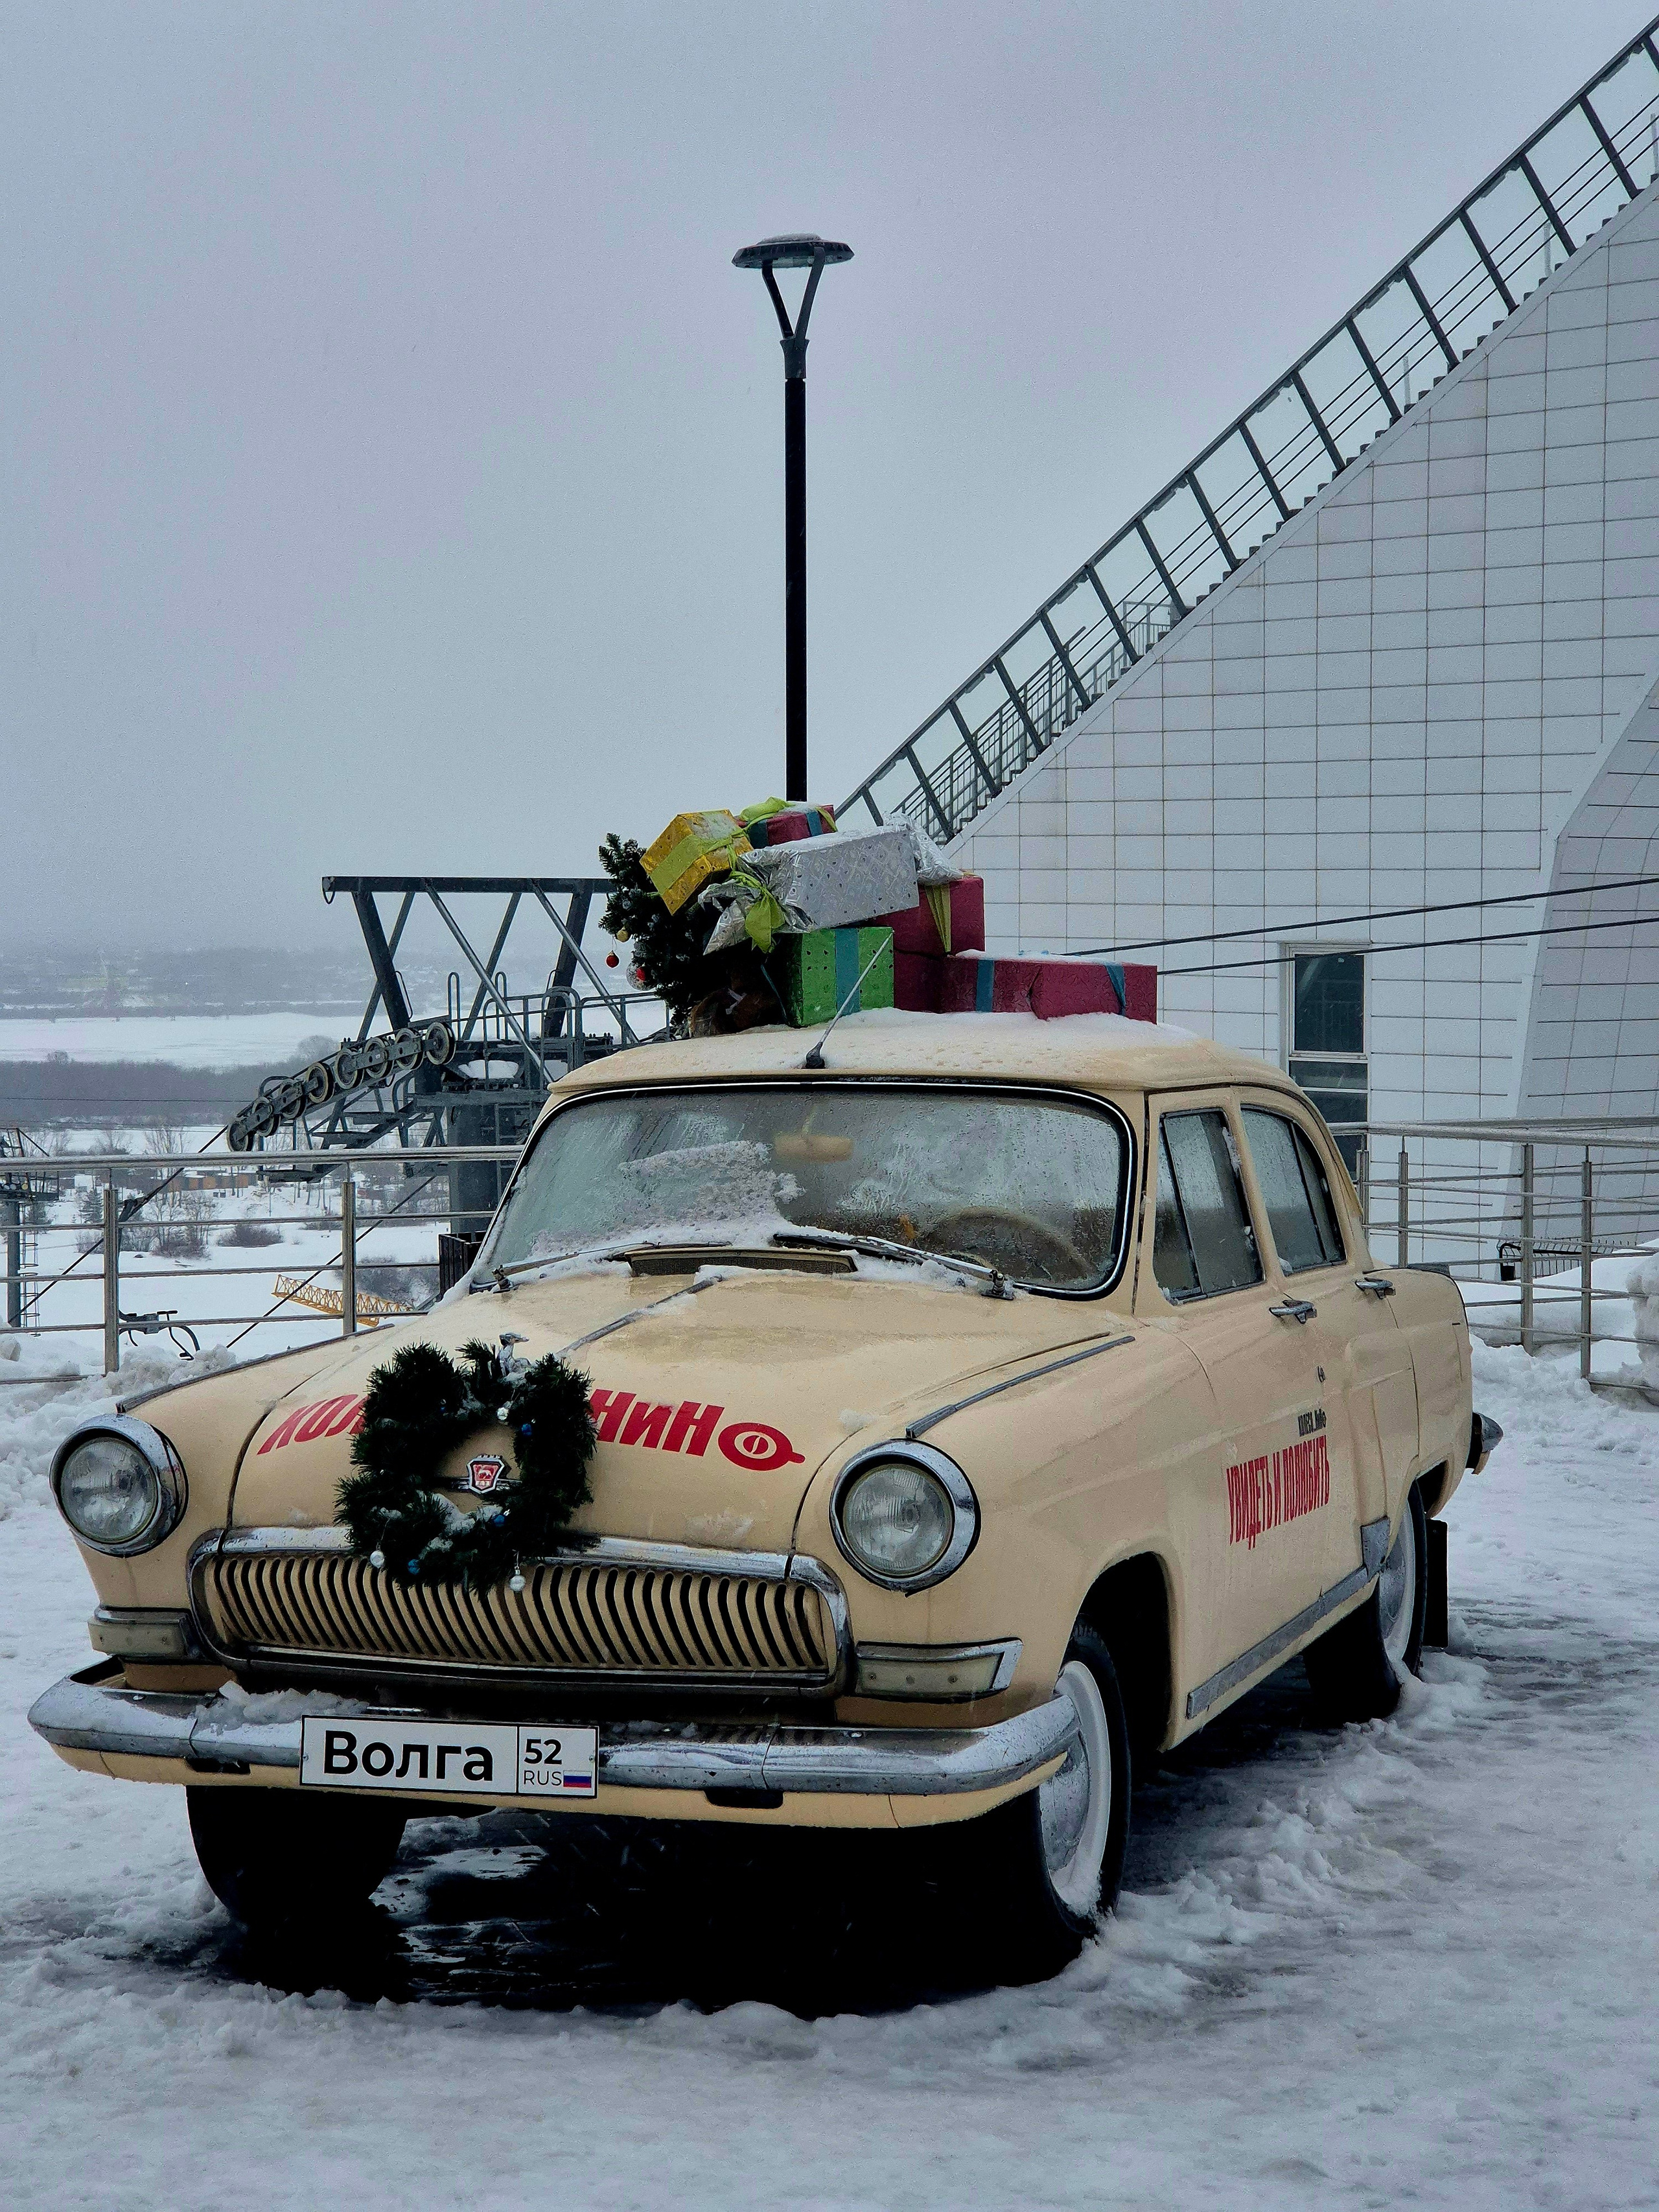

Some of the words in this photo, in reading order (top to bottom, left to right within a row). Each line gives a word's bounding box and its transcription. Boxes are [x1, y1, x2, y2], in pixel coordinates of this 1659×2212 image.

[257, 1394, 371, 1455] КОЛ
[1226, 1455, 1273, 1550] УВИДЕТЬ
[1273, 1451, 1281, 1528] И
[1282, 1434, 1330, 1522] ПОЛЮБИТЬ
[323, 1729, 493, 1782] Волга
[524, 1739, 563, 1765] 52
[524, 1769, 562, 1786] RUS
